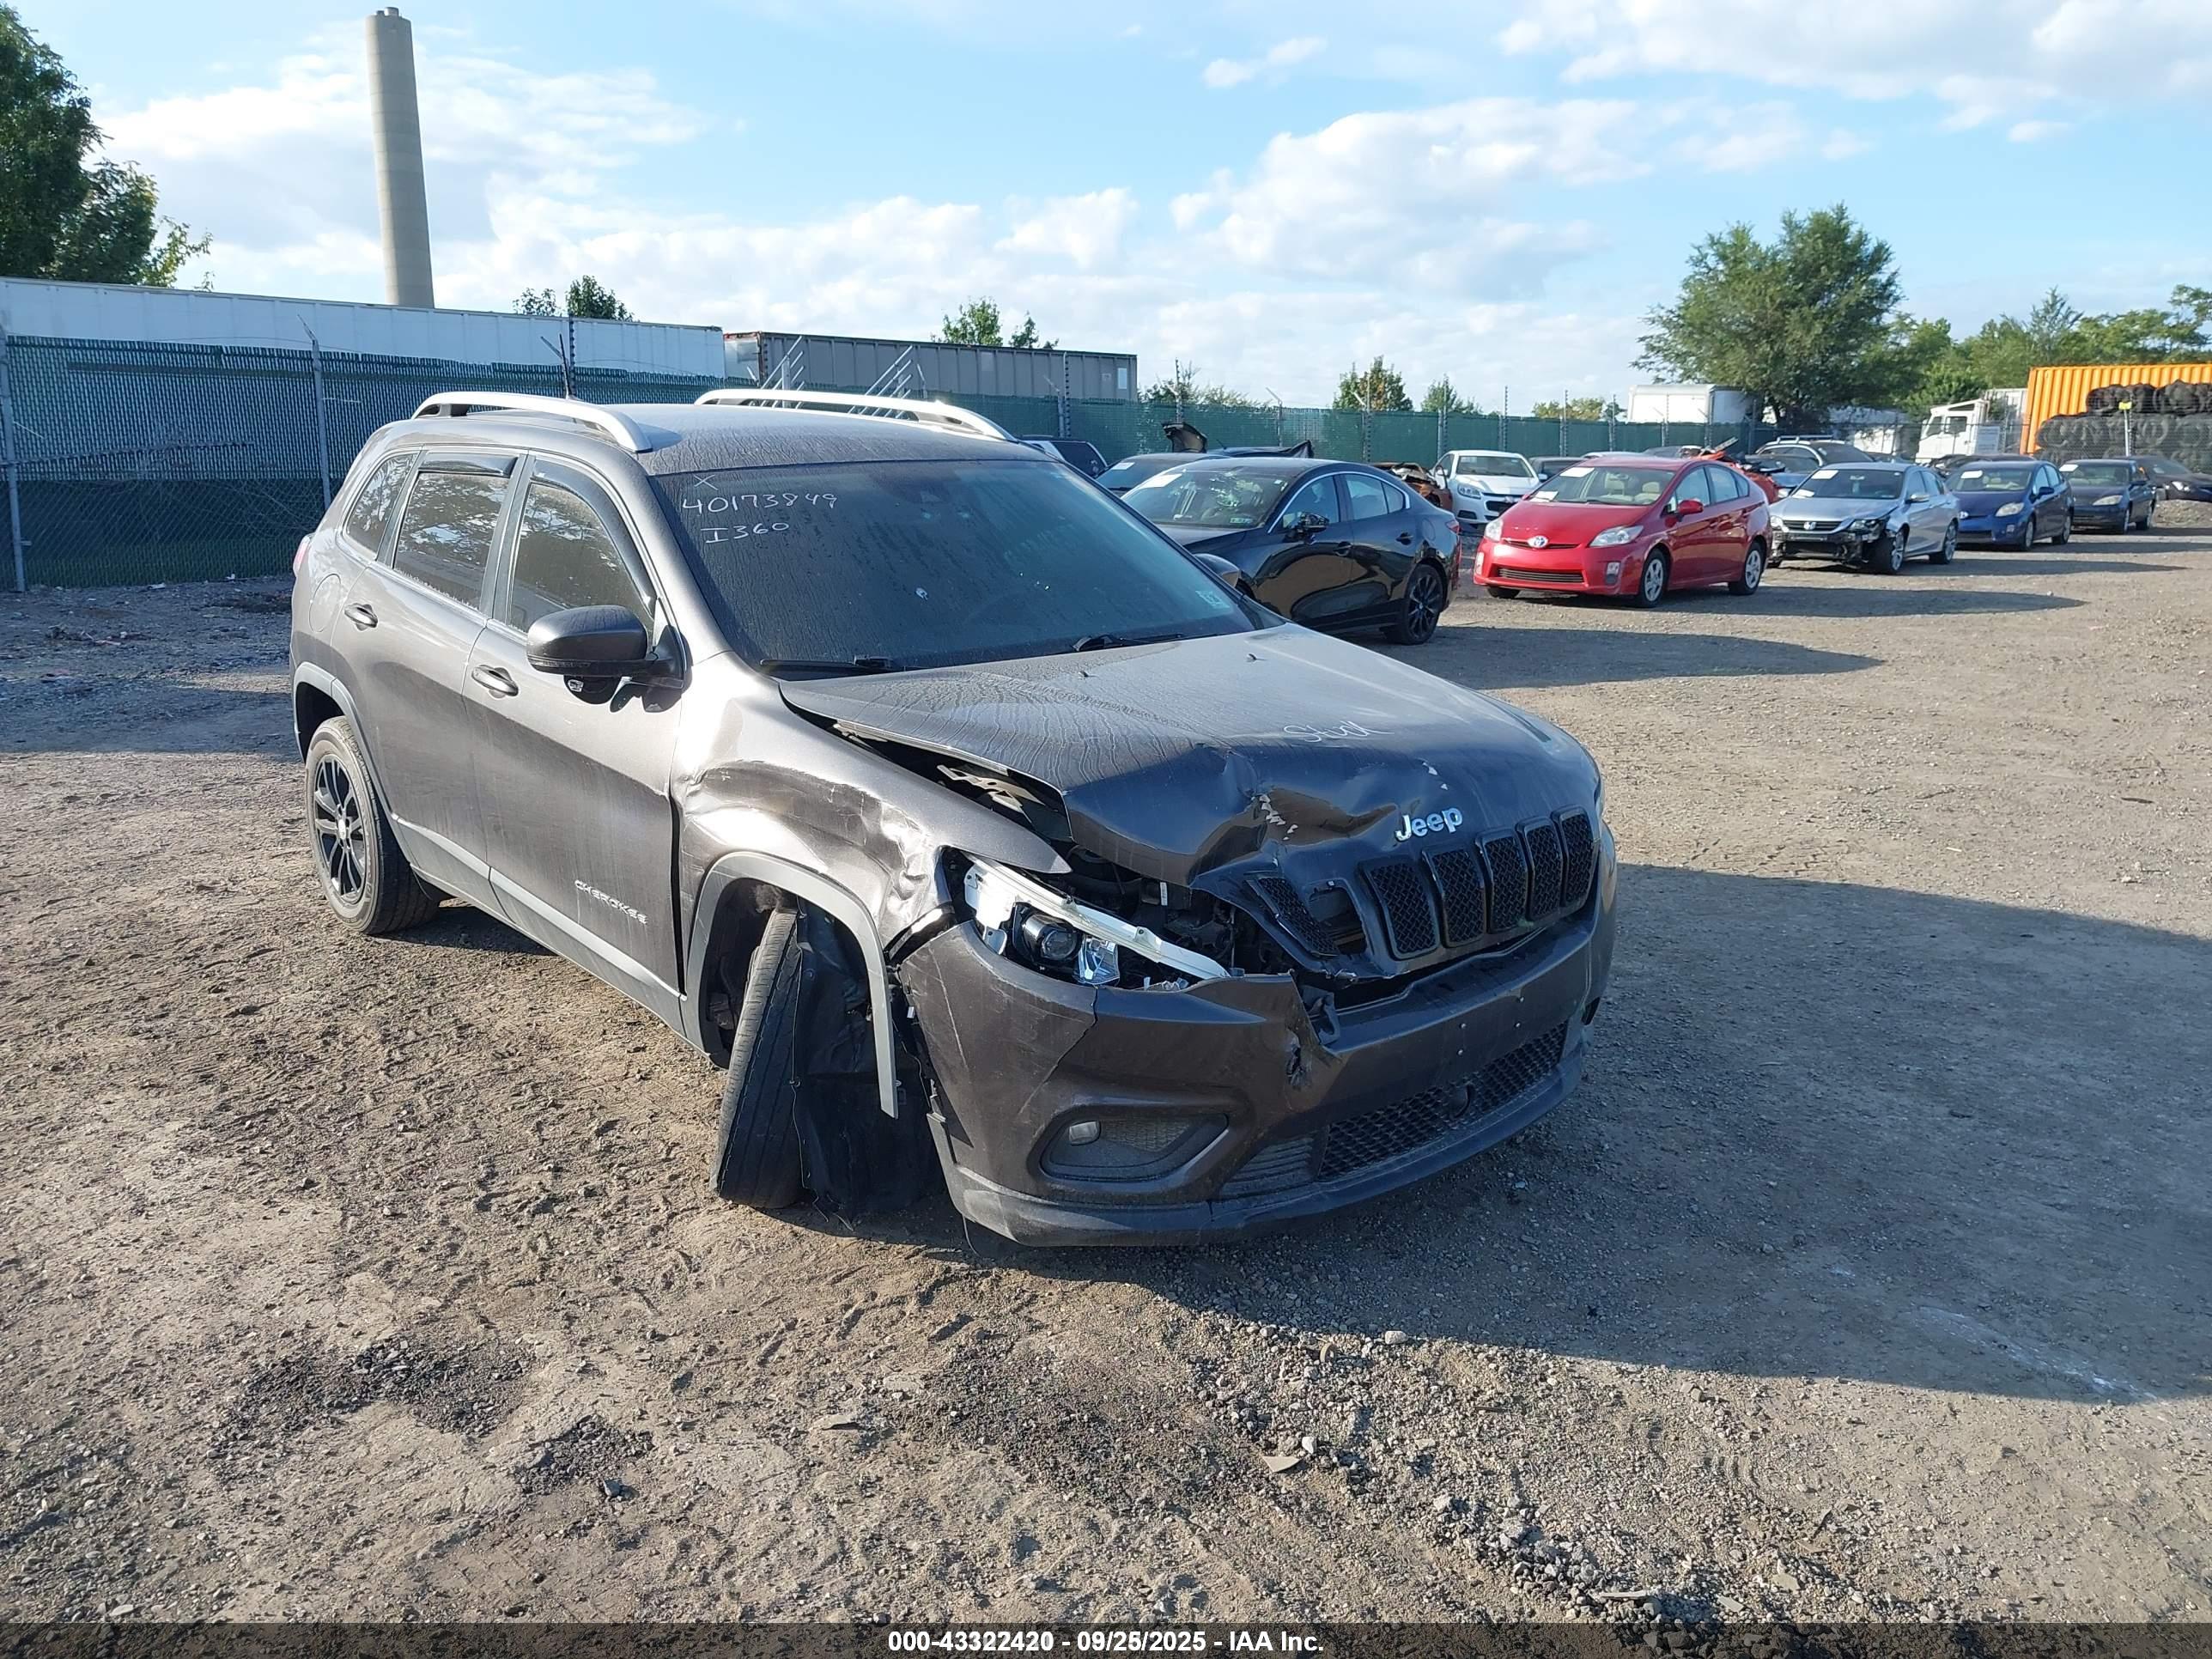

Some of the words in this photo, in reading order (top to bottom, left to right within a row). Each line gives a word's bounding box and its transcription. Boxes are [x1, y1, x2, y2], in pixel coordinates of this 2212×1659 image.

[682, 493, 838, 515] 40173849
[1395, 807, 1463, 842] Jeep
[574, 879, 648, 925] CHEROKEE
